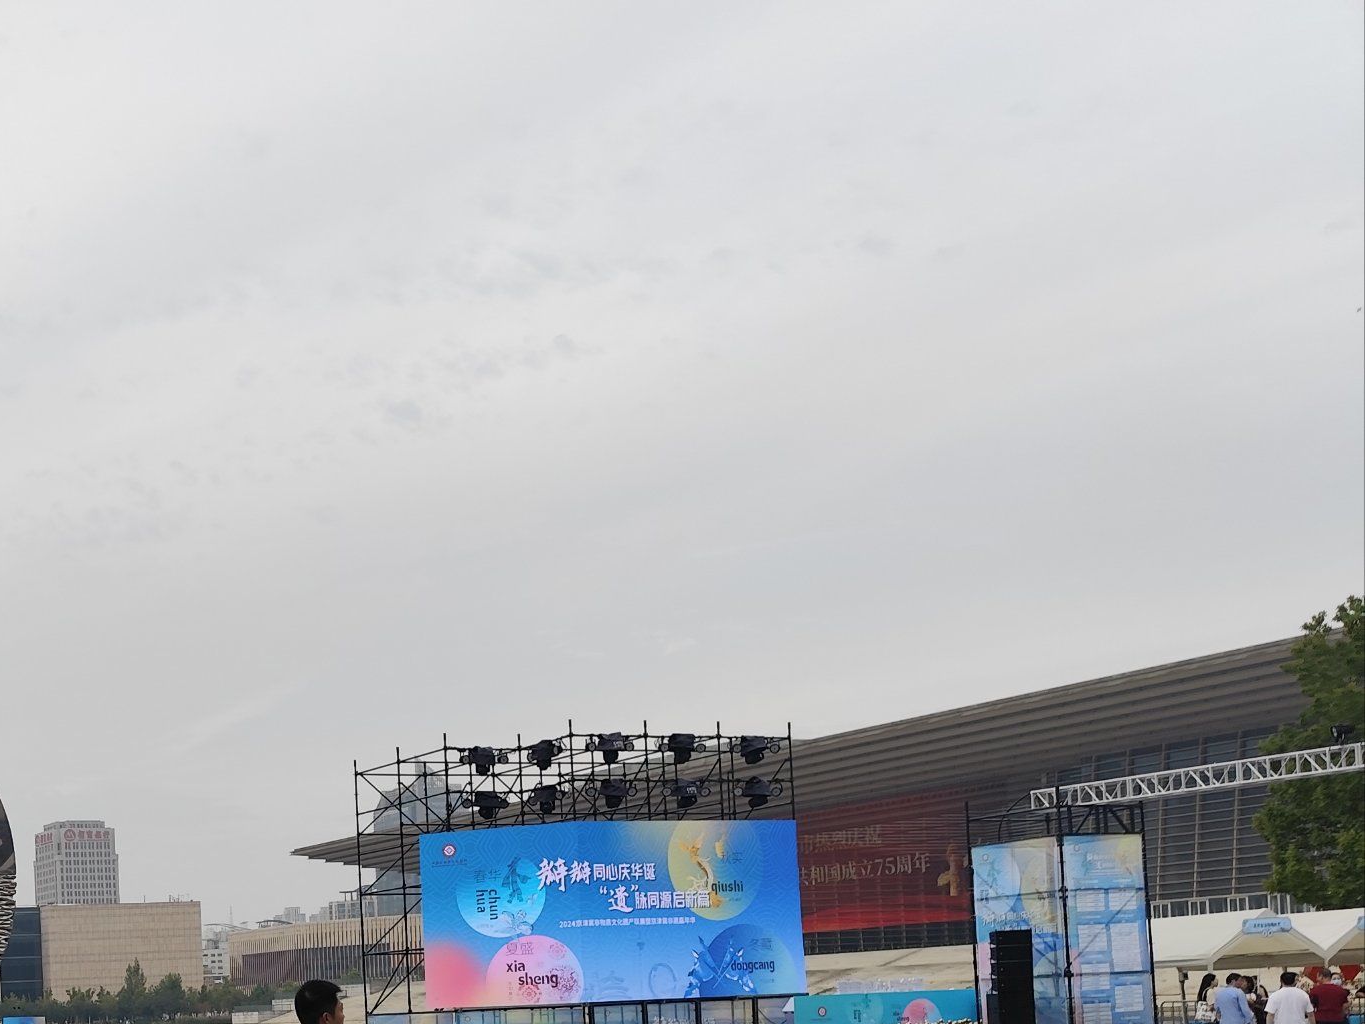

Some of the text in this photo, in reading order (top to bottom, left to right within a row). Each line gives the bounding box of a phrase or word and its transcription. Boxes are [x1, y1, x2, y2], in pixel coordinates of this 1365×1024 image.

[711, 880, 744, 895] qiushi
[476, 889, 488, 913] hua
[488, 889, 500, 920] chun
[506, 960, 526, 973] xia
[518, 972, 559, 988] sheng
